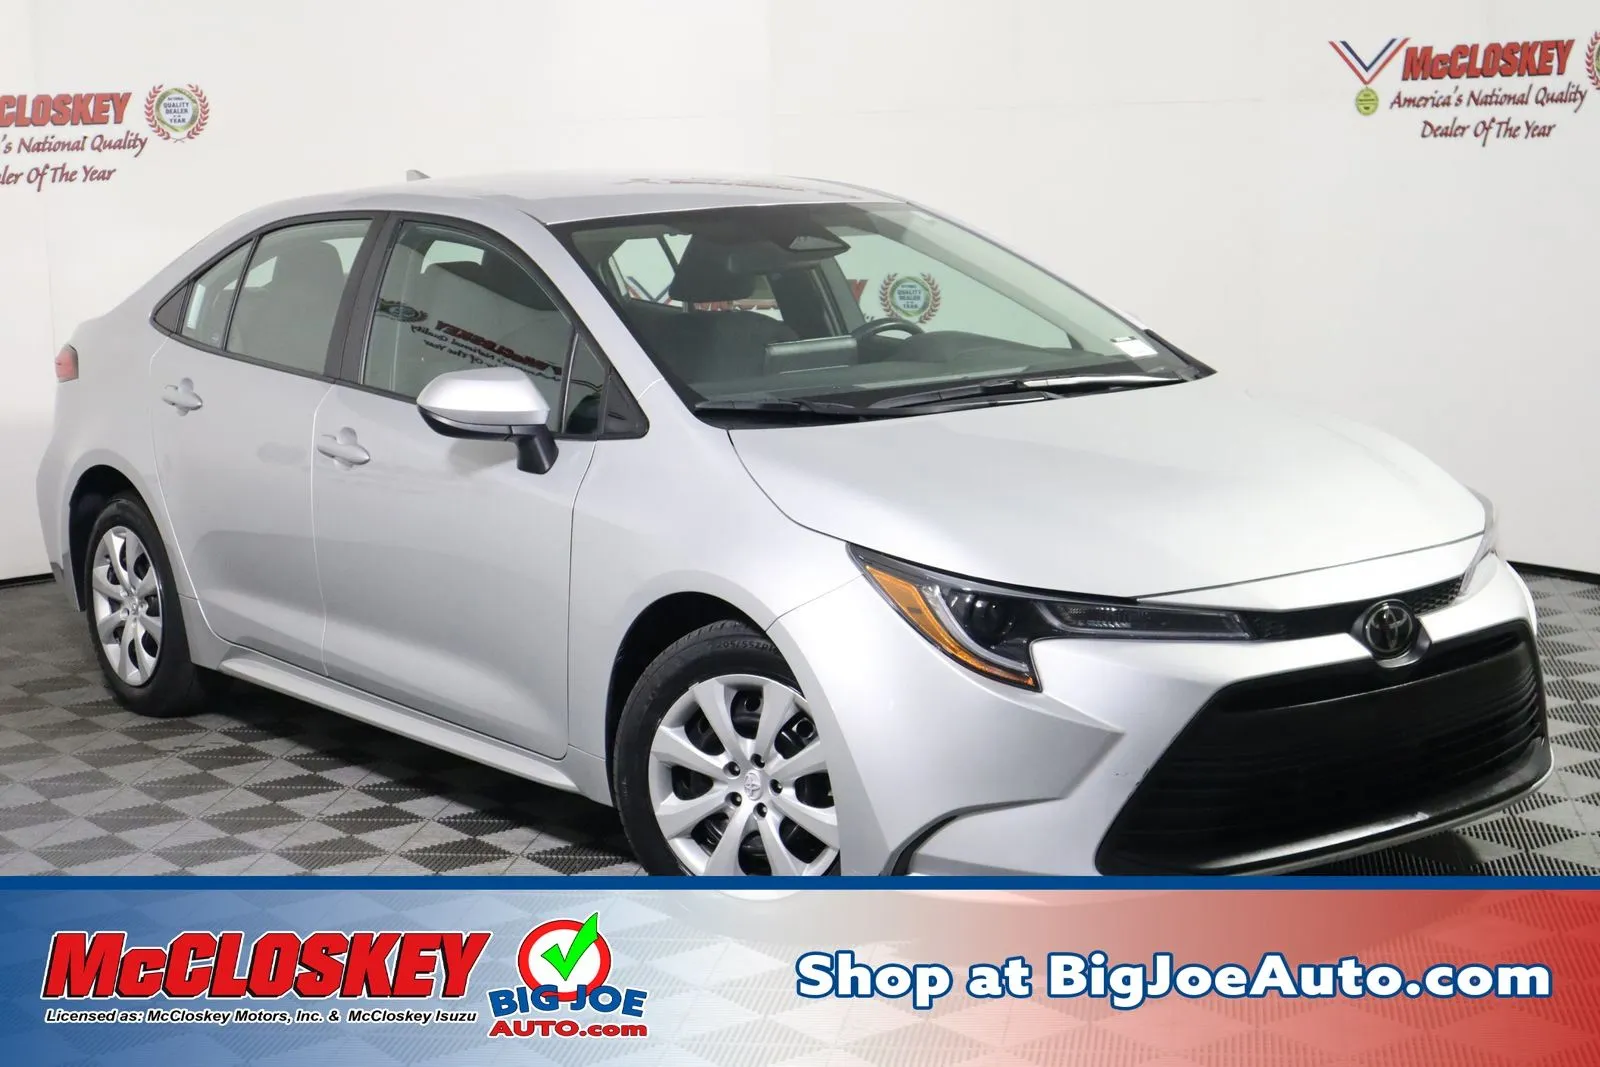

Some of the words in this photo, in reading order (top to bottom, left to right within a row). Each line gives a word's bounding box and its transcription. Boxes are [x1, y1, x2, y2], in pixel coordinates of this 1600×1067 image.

[1402, 39, 1575, 81] McCLOSKEY
[1390, 85, 1463, 109] America's
[1467, 83, 1533, 107] National
[1535, 81, 1588, 113] Quality
[17, 135, 87, 152] National
[91, 130, 148, 157] Quality
[1421, 117, 1470, 138] Dealer
[1474, 117, 1495, 147] Of
[1496, 117, 1520, 138] The
[1524, 120, 1556, 139] Year
[27, 163, 50, 192] Of
[50, 163, 77, 183] The
[82, 165, 116, 182] Year
